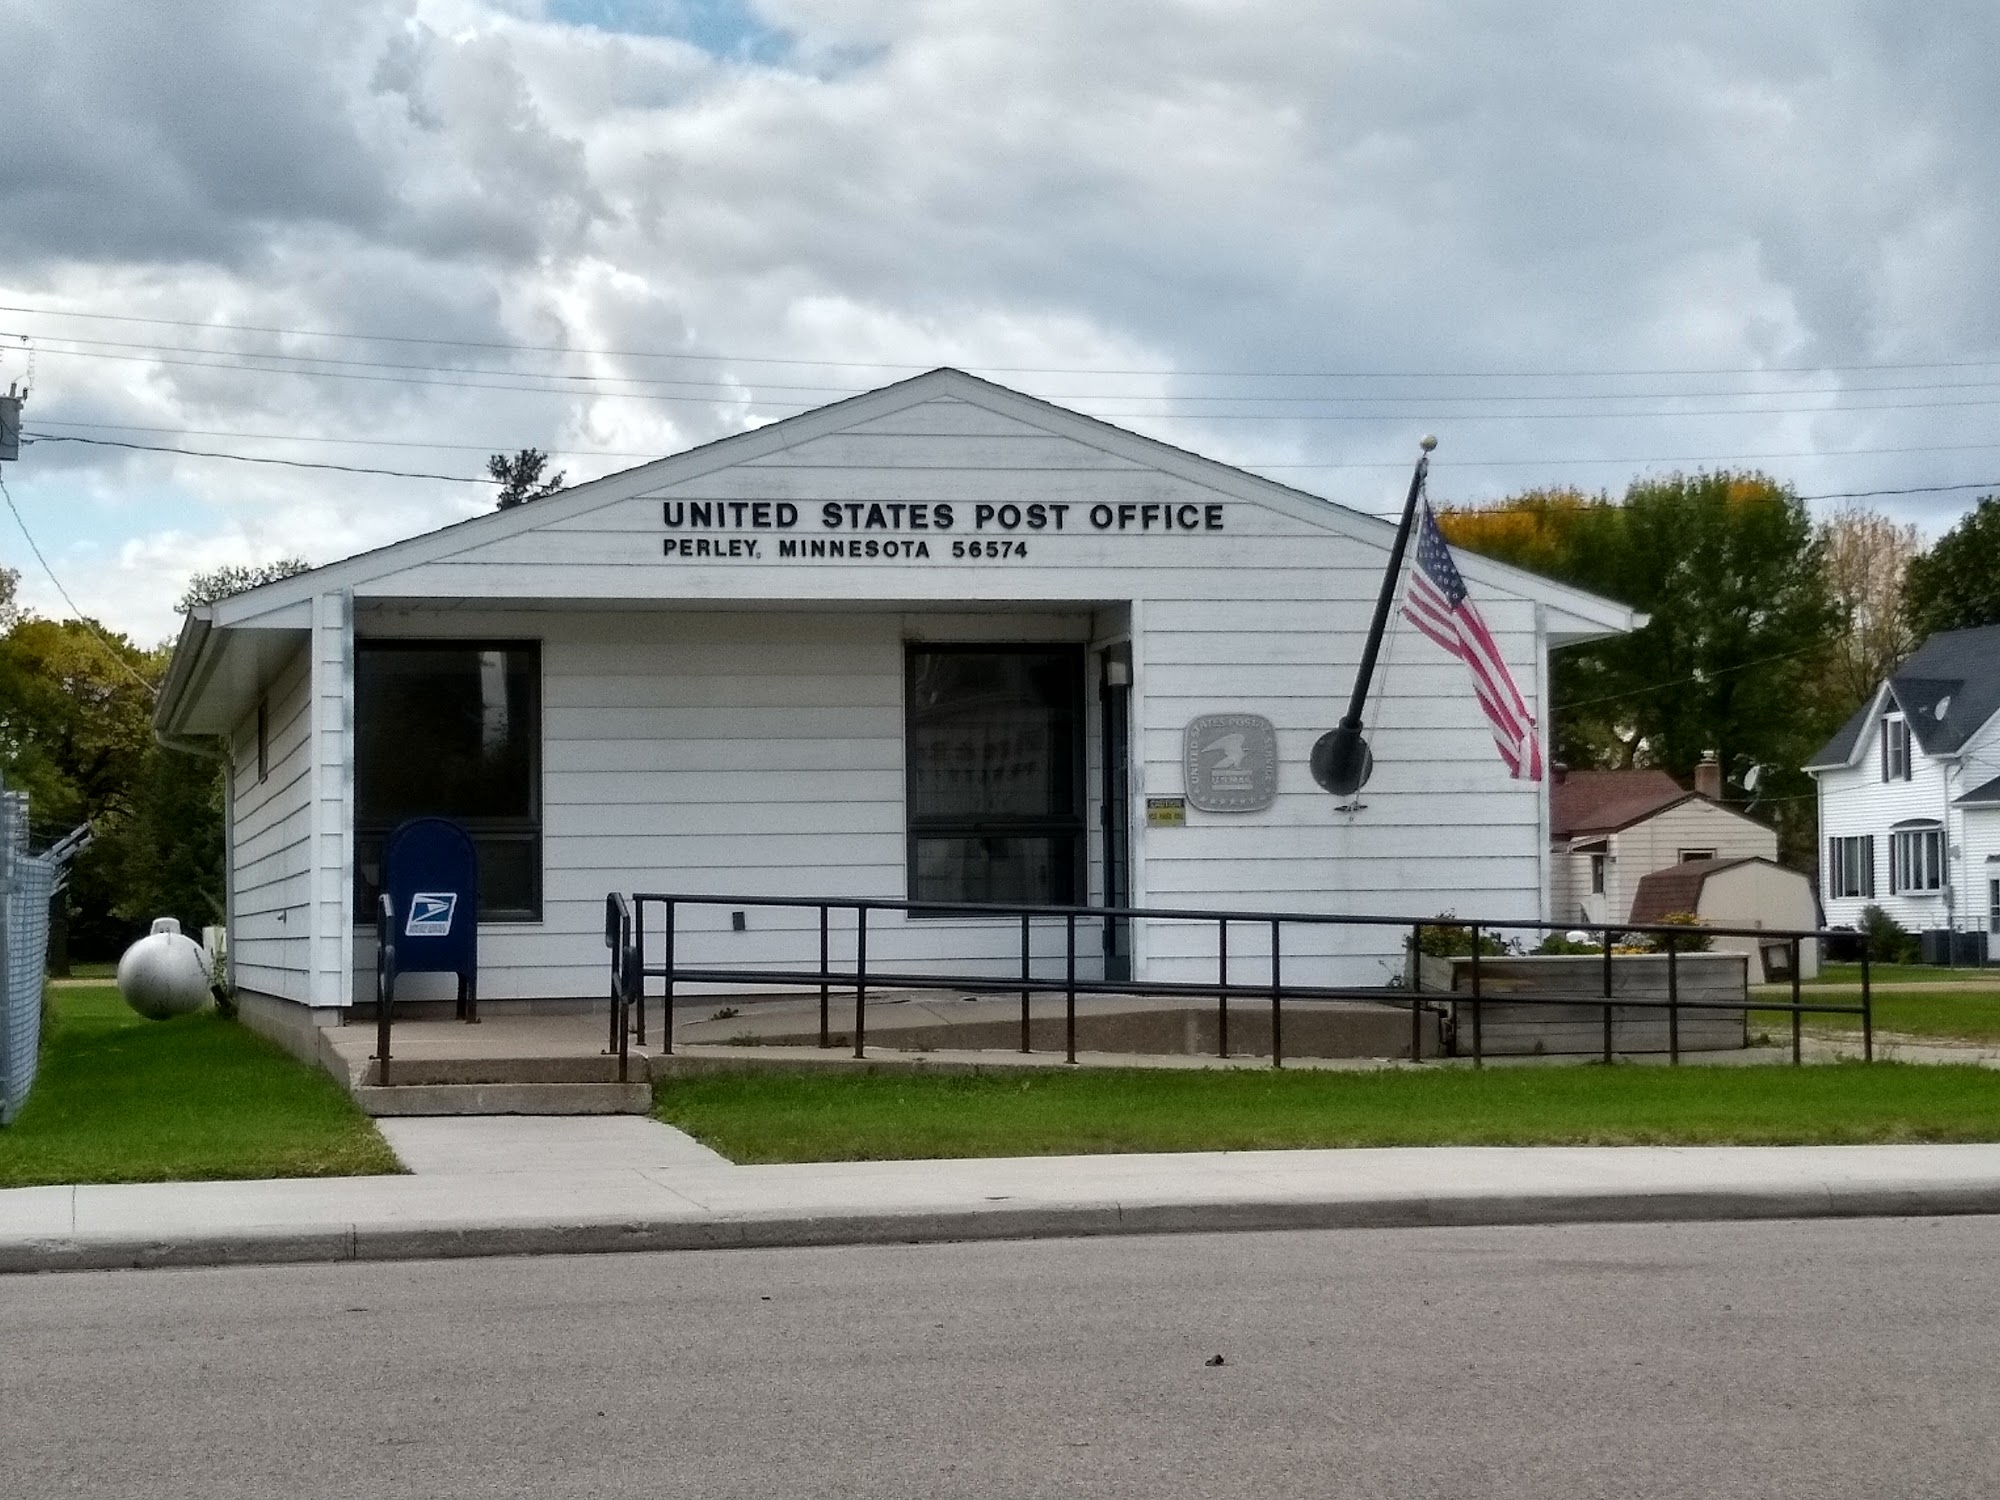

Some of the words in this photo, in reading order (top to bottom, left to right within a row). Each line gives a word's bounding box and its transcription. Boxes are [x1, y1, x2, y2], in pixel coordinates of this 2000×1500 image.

[663, 502, 798, 528] UNITED
[821, 502, 954, 529] STATES
[975, 503, 1069, 530] POST
[1089, 503, 1224, 530] OFFICE
[779, 539, 930, 558] MINNESOTA
[951, 541, 1028, 558] 56574
